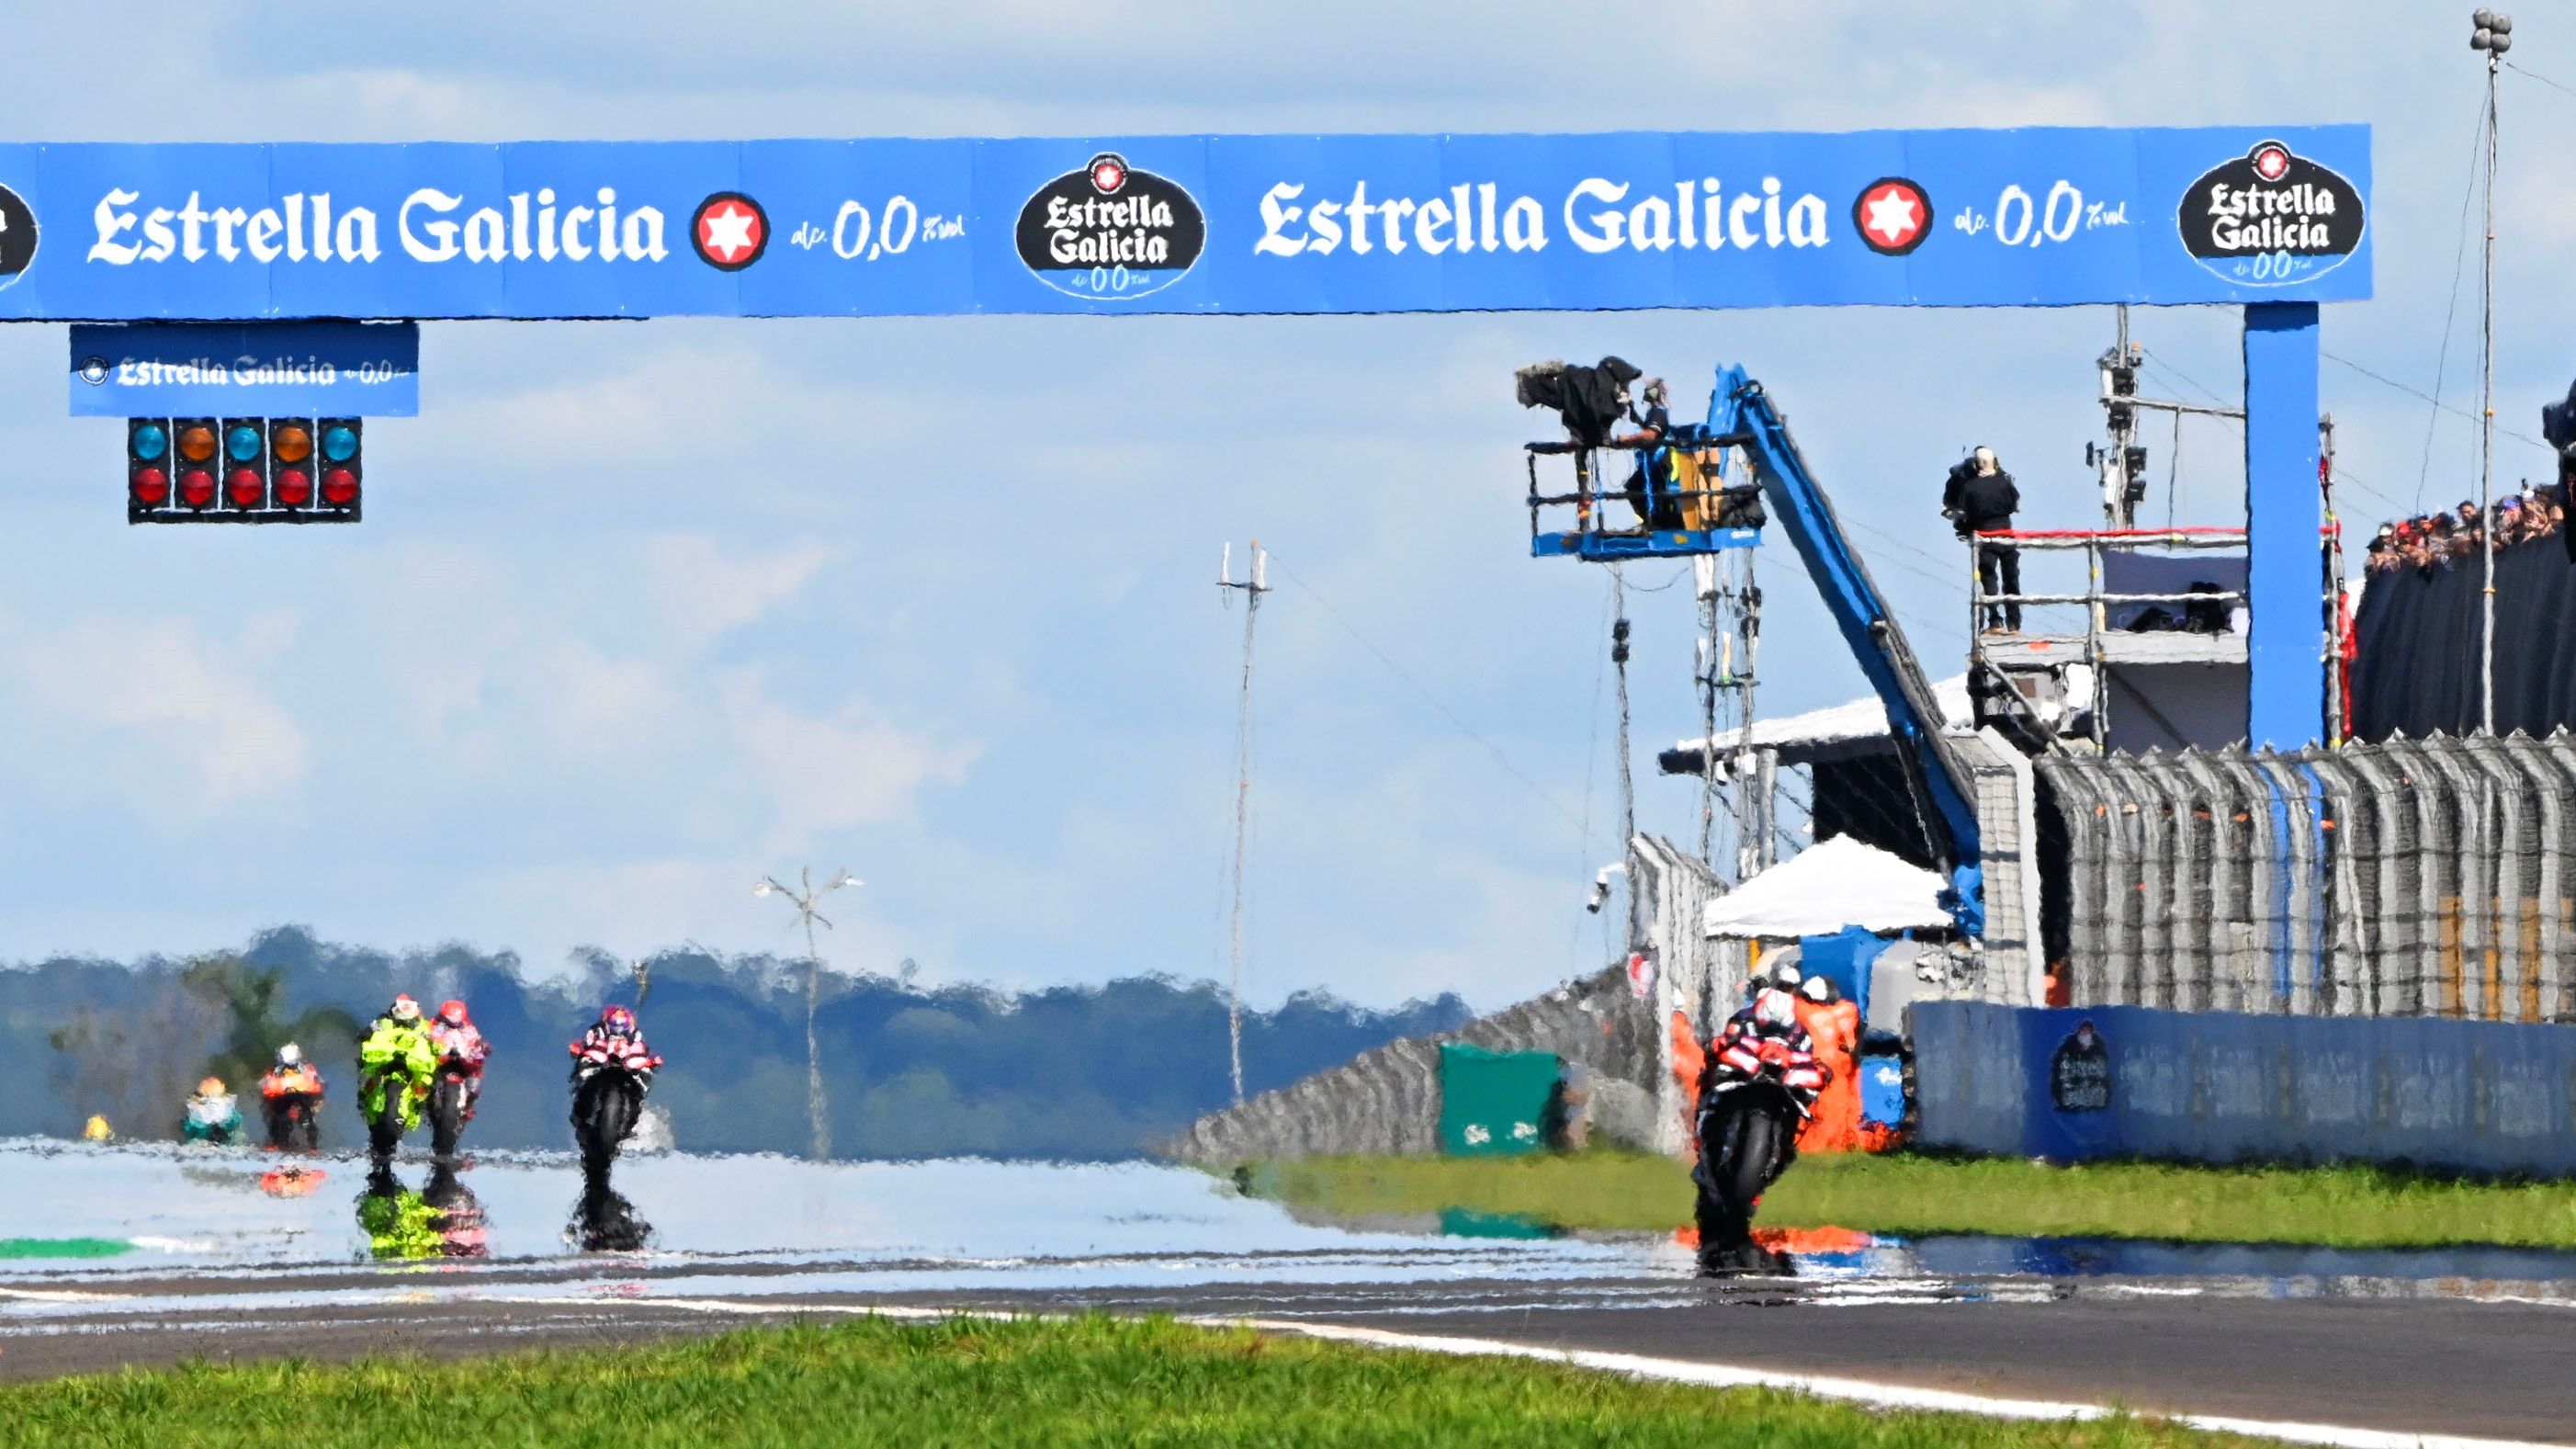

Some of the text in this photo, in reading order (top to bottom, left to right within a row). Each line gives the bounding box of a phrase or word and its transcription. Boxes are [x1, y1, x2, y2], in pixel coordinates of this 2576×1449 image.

[1044, 194, 1175, 229] Estrella
[1253, 180, 1549, 257] Estrella
[1564, 176, 1830, 254] Galicia
[1994, 179, 2084, 248] 0,0
[2208, 183, 2336, 217] Estrella
[87, 187, 381, 266] Estrella
[399, 187, 670, 265] Galicia
[832, 195, 918, 261] 0,0
[2211, 215, 2331, 250] Galicia
[1049, 229, 1169, 264] Galicia
[117, 357, 230, 387] Estrella
[232, 355, 337, 387] Galicia
